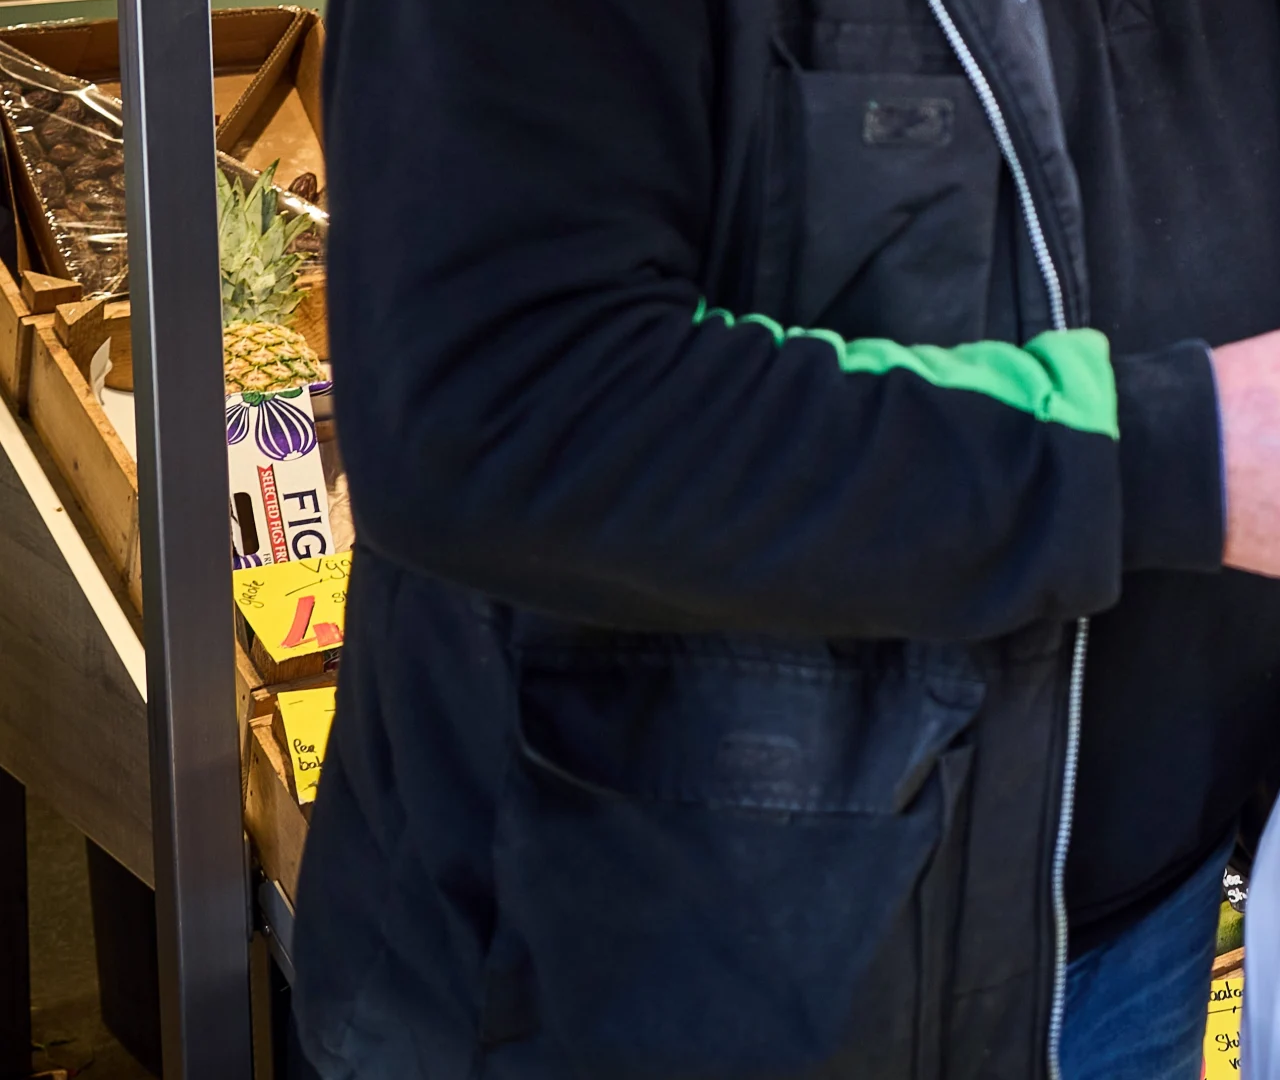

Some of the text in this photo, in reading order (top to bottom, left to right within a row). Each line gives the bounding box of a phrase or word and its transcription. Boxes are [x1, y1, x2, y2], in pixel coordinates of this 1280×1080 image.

[261, 470, 281, 519] SELECTED
[270, 517, 287, 546] FIGS
[283, 488, 332, 560] FIG
